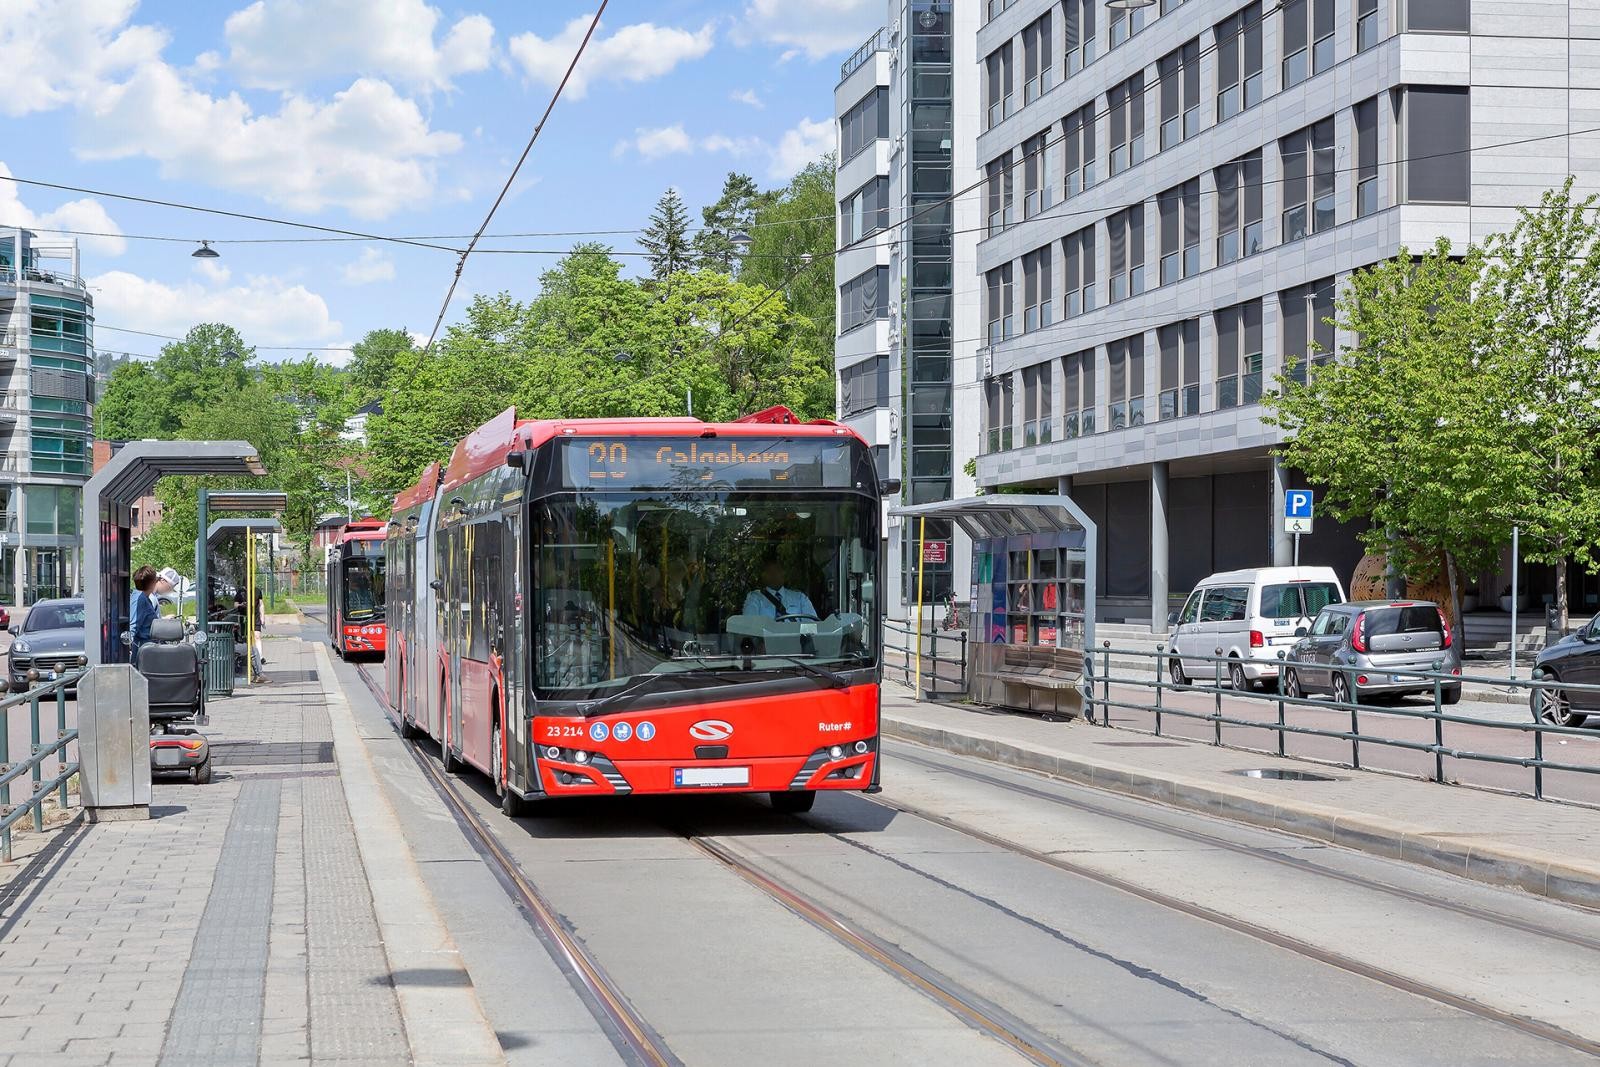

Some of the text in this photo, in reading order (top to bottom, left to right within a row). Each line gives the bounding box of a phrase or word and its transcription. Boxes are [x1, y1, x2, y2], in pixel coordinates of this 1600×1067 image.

[1292, 494, 1307, 514] P
[547, 726, 584, 737] 23 214
[818, 721, 853, 732] Ruter#
